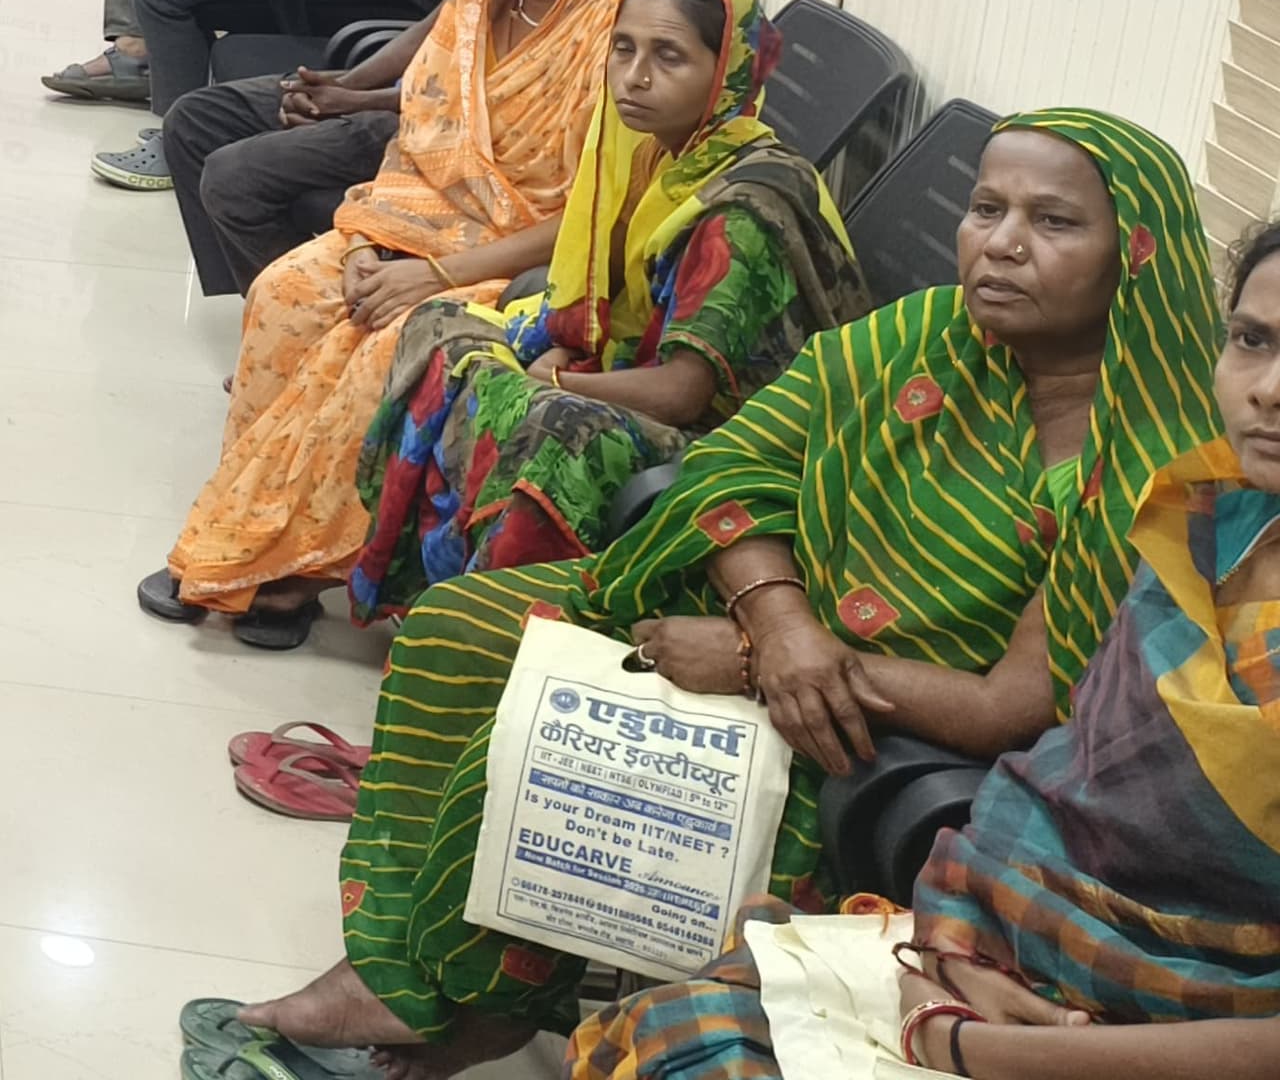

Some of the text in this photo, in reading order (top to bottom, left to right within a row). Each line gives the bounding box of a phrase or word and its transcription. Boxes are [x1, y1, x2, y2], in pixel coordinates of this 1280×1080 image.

[585, 696, 746, 757] एडुकार्व
[540, 719, 740, 796] कैरियर इन्स्टीच्यूट
[638, 779, 682, 798] OLYMPIAD
[525, 789, 730, 859] Is your Dream IIT/NEET ?
[565, 819, 679, 863] Don't be Late.
[518, 827, 633, 874] EDUCARVE
[651, 904, 688, 924] Going
